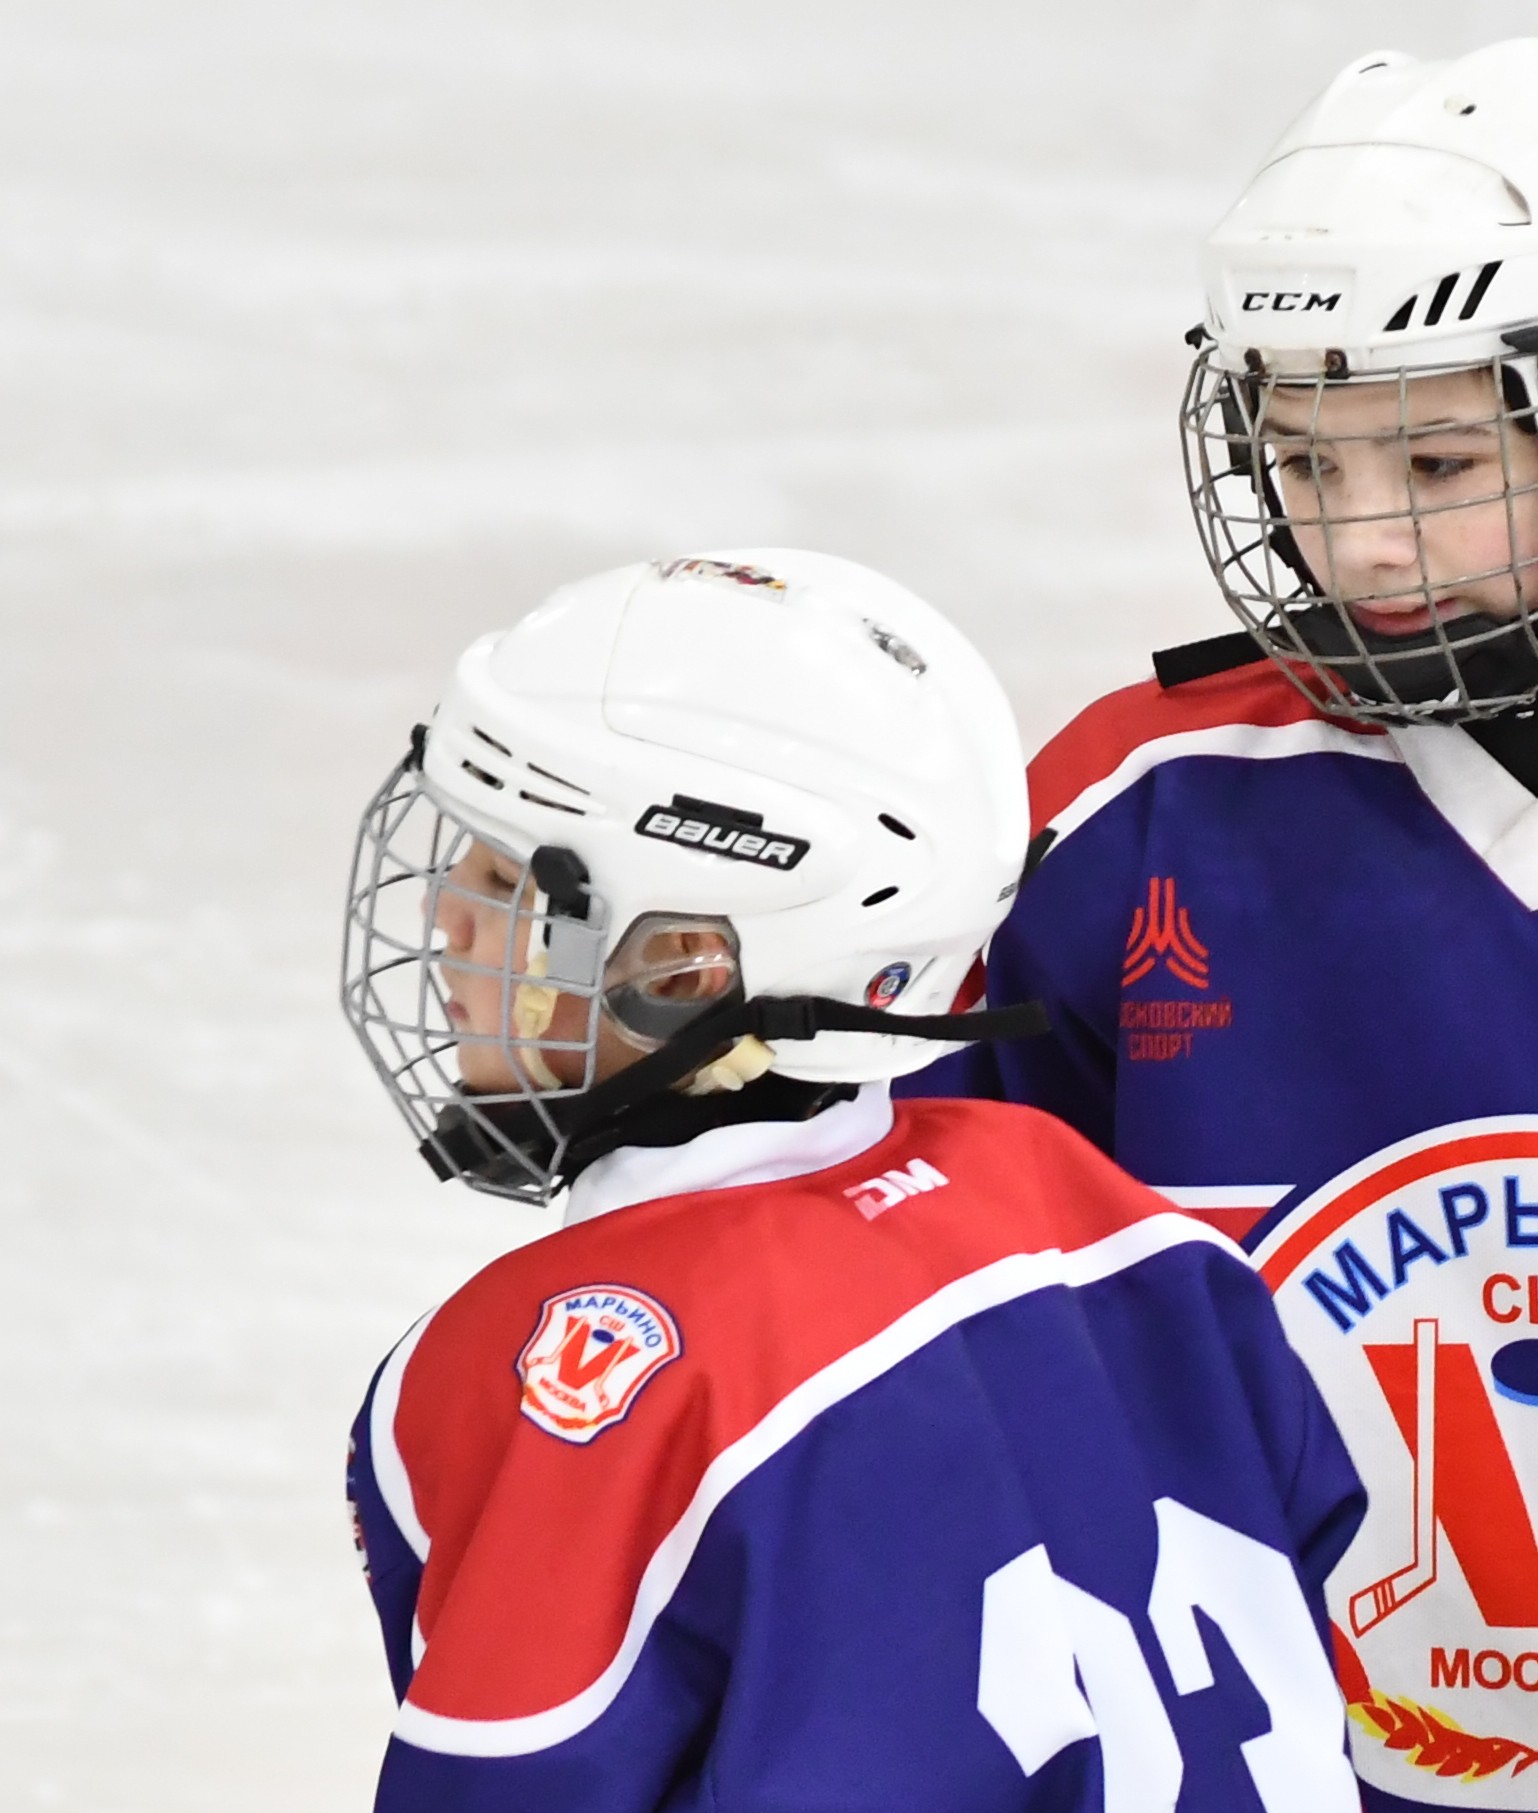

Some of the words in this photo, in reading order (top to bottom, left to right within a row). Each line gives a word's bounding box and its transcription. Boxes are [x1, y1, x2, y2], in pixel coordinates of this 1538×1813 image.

[1241, 292, 1342, 312] CCM
[644, 813, 797, 866] BAUER
[565, 1296, 662, 1348] МАРЬИНО
[599, 1315, 625, 1332] СШ
